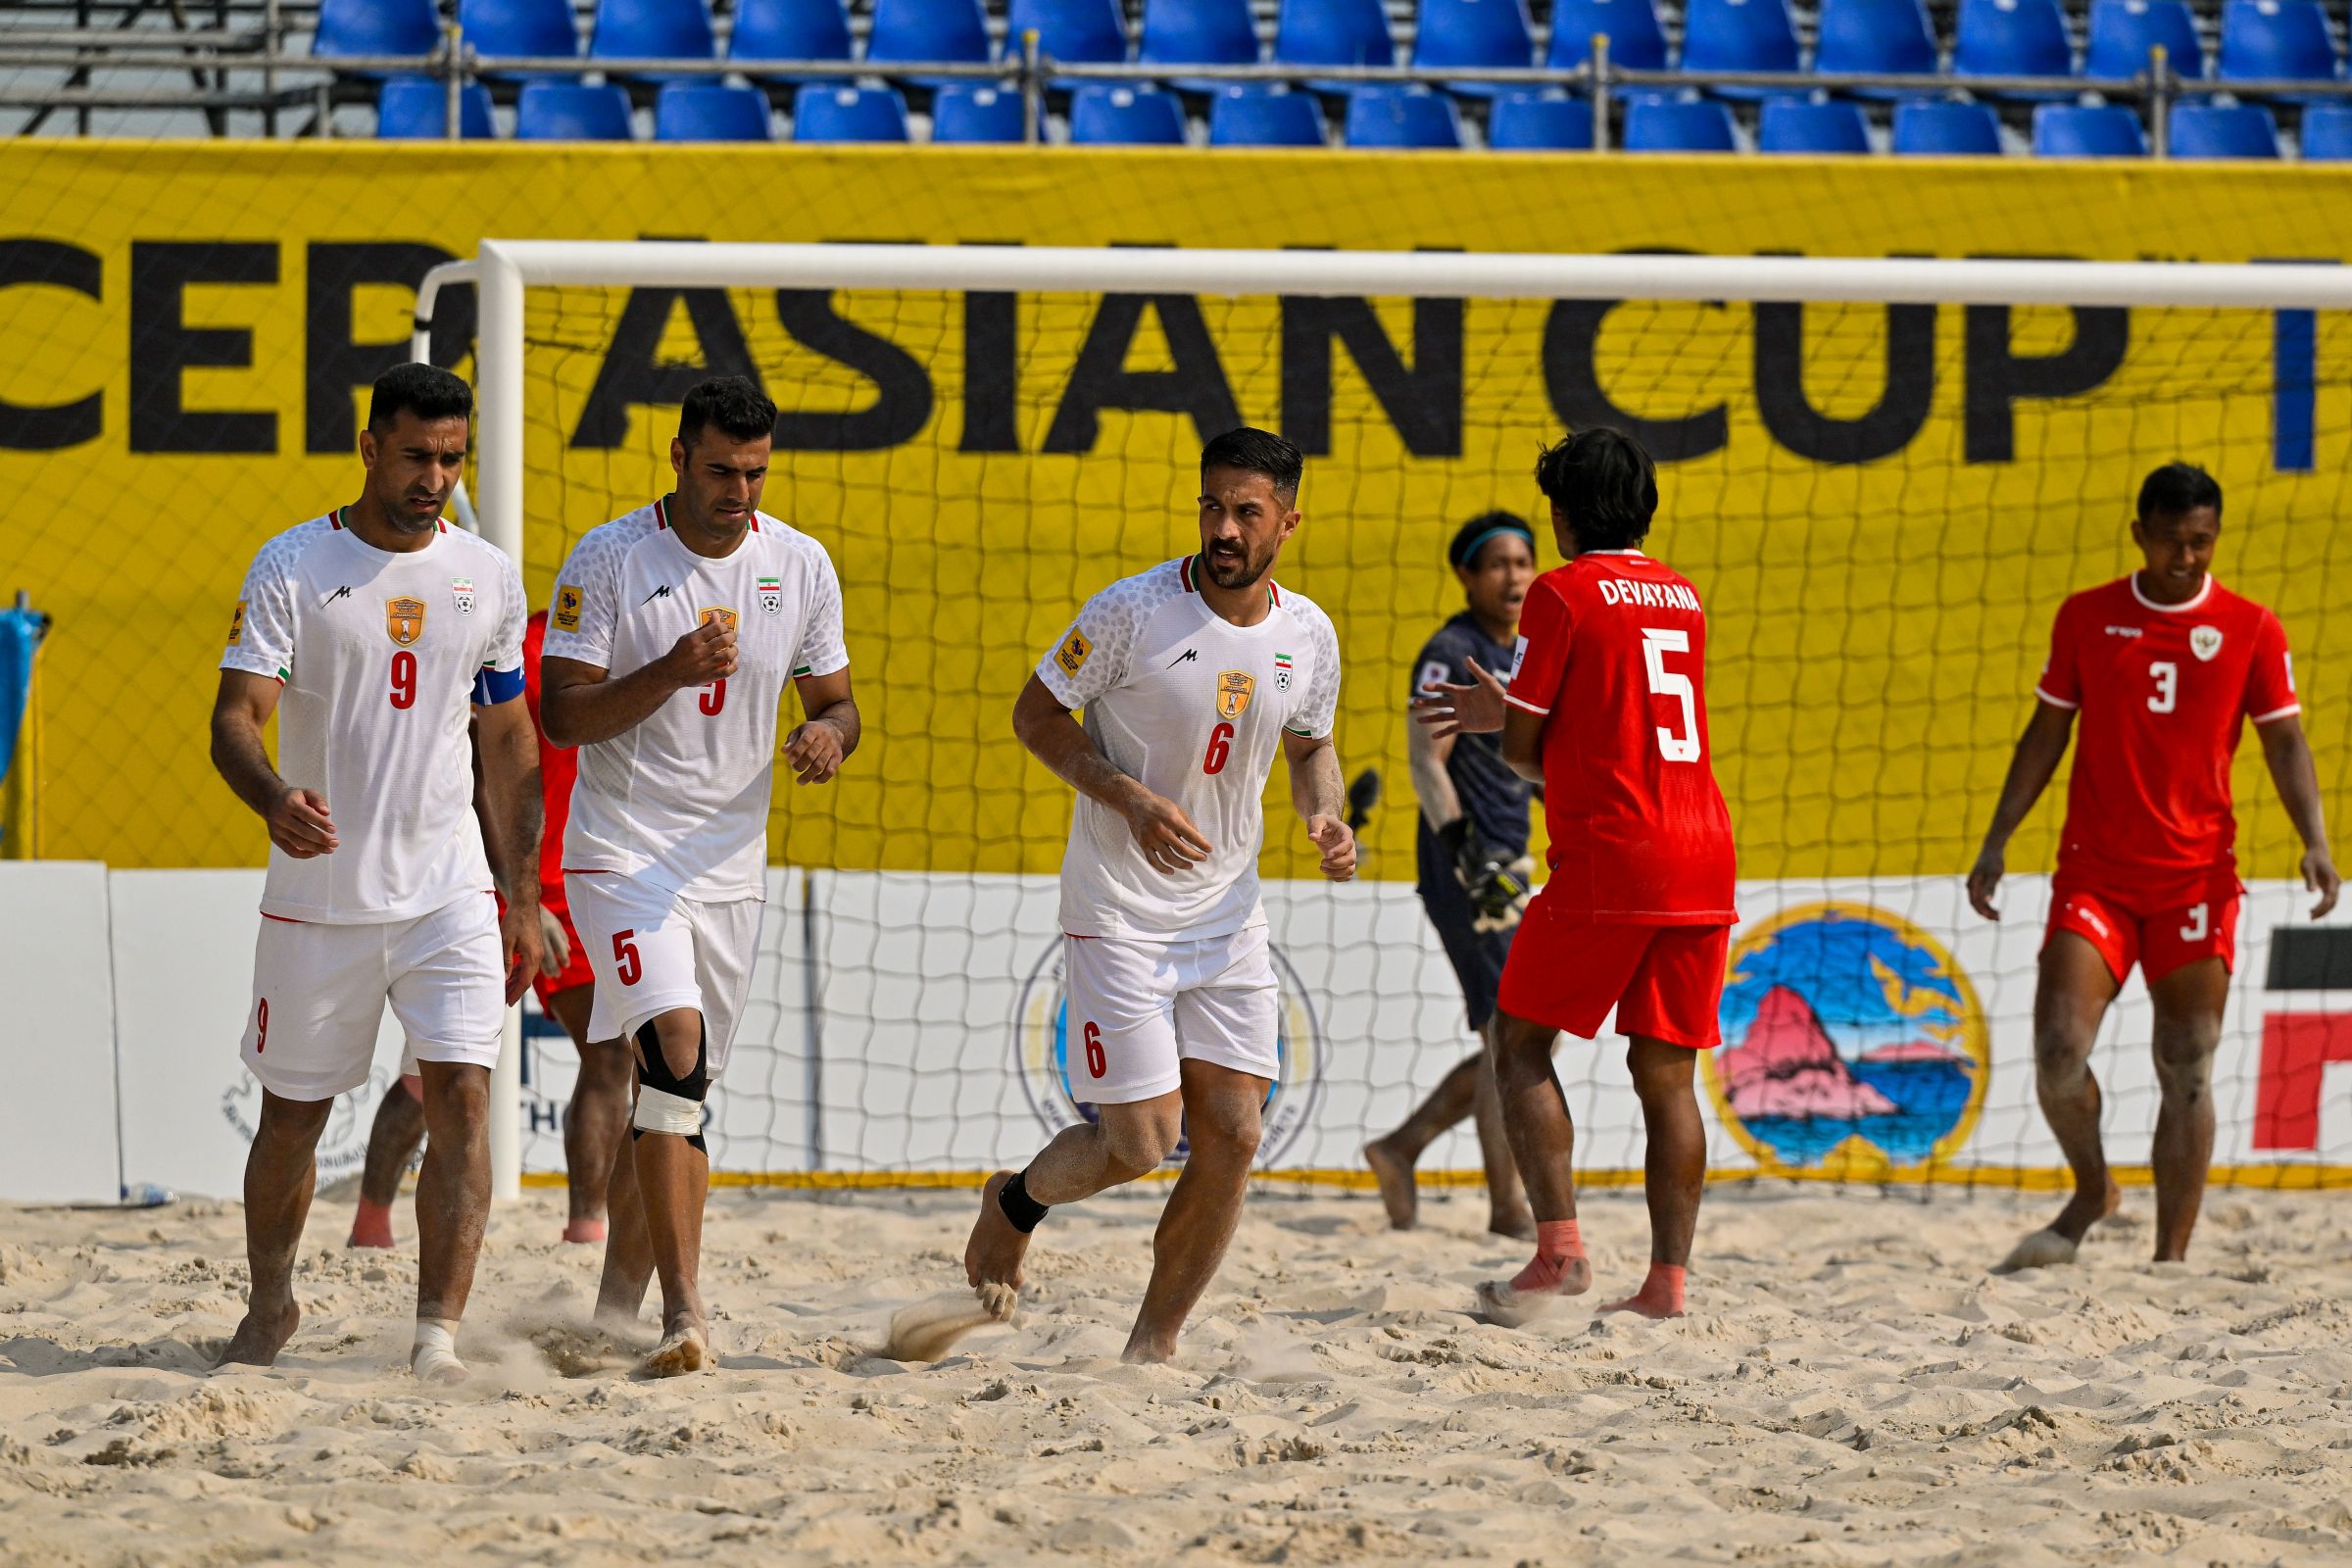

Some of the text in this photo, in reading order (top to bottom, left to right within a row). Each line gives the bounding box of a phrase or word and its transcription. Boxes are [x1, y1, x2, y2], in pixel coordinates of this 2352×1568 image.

[570, 235, 1466, 458] ASIAN
[1542, 246, 2131, 465] CUP
[1597, 578, 1701, 612] DEVAYANA
[389, 650, 418, 710] 9
[1641, 627, 1701, 763] 5
[2147, 661, 2178, 713] 3
[1202, 721, 1235, 775] 6
[612, 928, 643, 987] 5
[256, 997, 270, 1054] 9
[1084, 1021, 1107, 1079] 6
